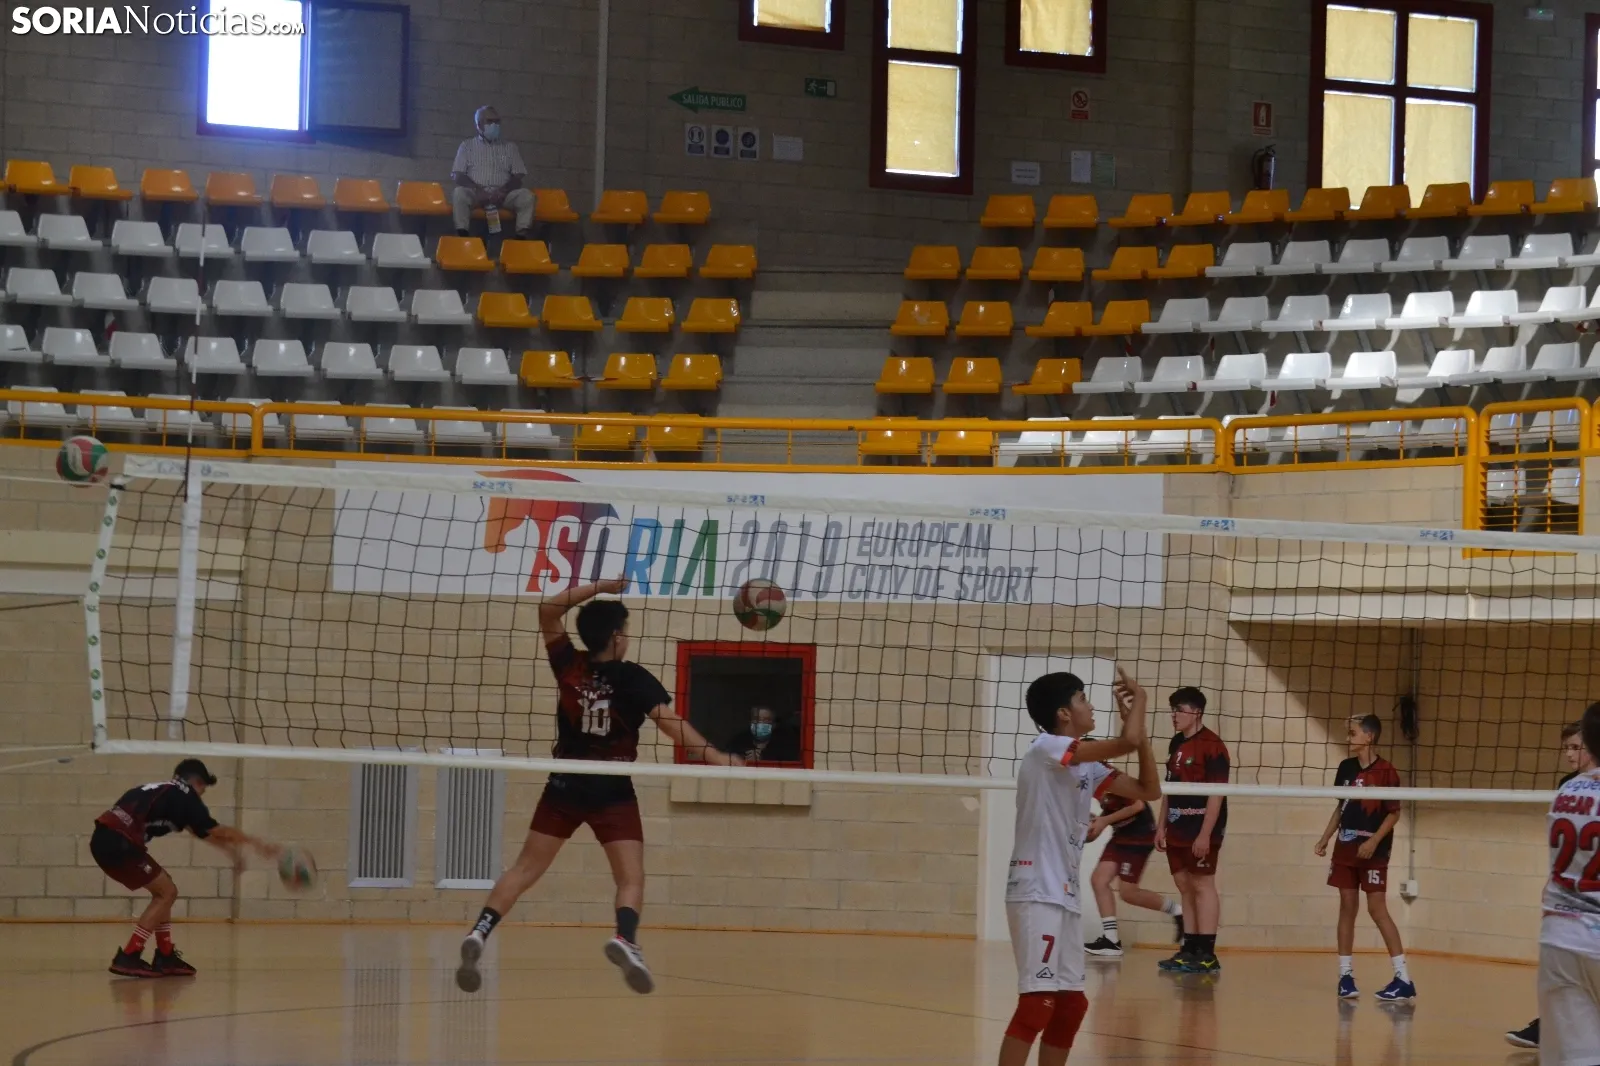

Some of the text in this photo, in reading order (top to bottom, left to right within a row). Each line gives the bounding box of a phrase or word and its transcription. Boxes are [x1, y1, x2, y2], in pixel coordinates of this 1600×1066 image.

[682, 93, 709, 106] SALIDA
[537, 514, 720, 597] SORIA
[857, 521, 993, 558] EUROPEAN
[848, 564, 1039, 602] CITY OF SPORT
[577, 699, 612, 737] 10
[1551, 817, 1600, 893] 22
[1367, 869, 1380, 885] 15
[1041, 934, 1055, 964] 7
